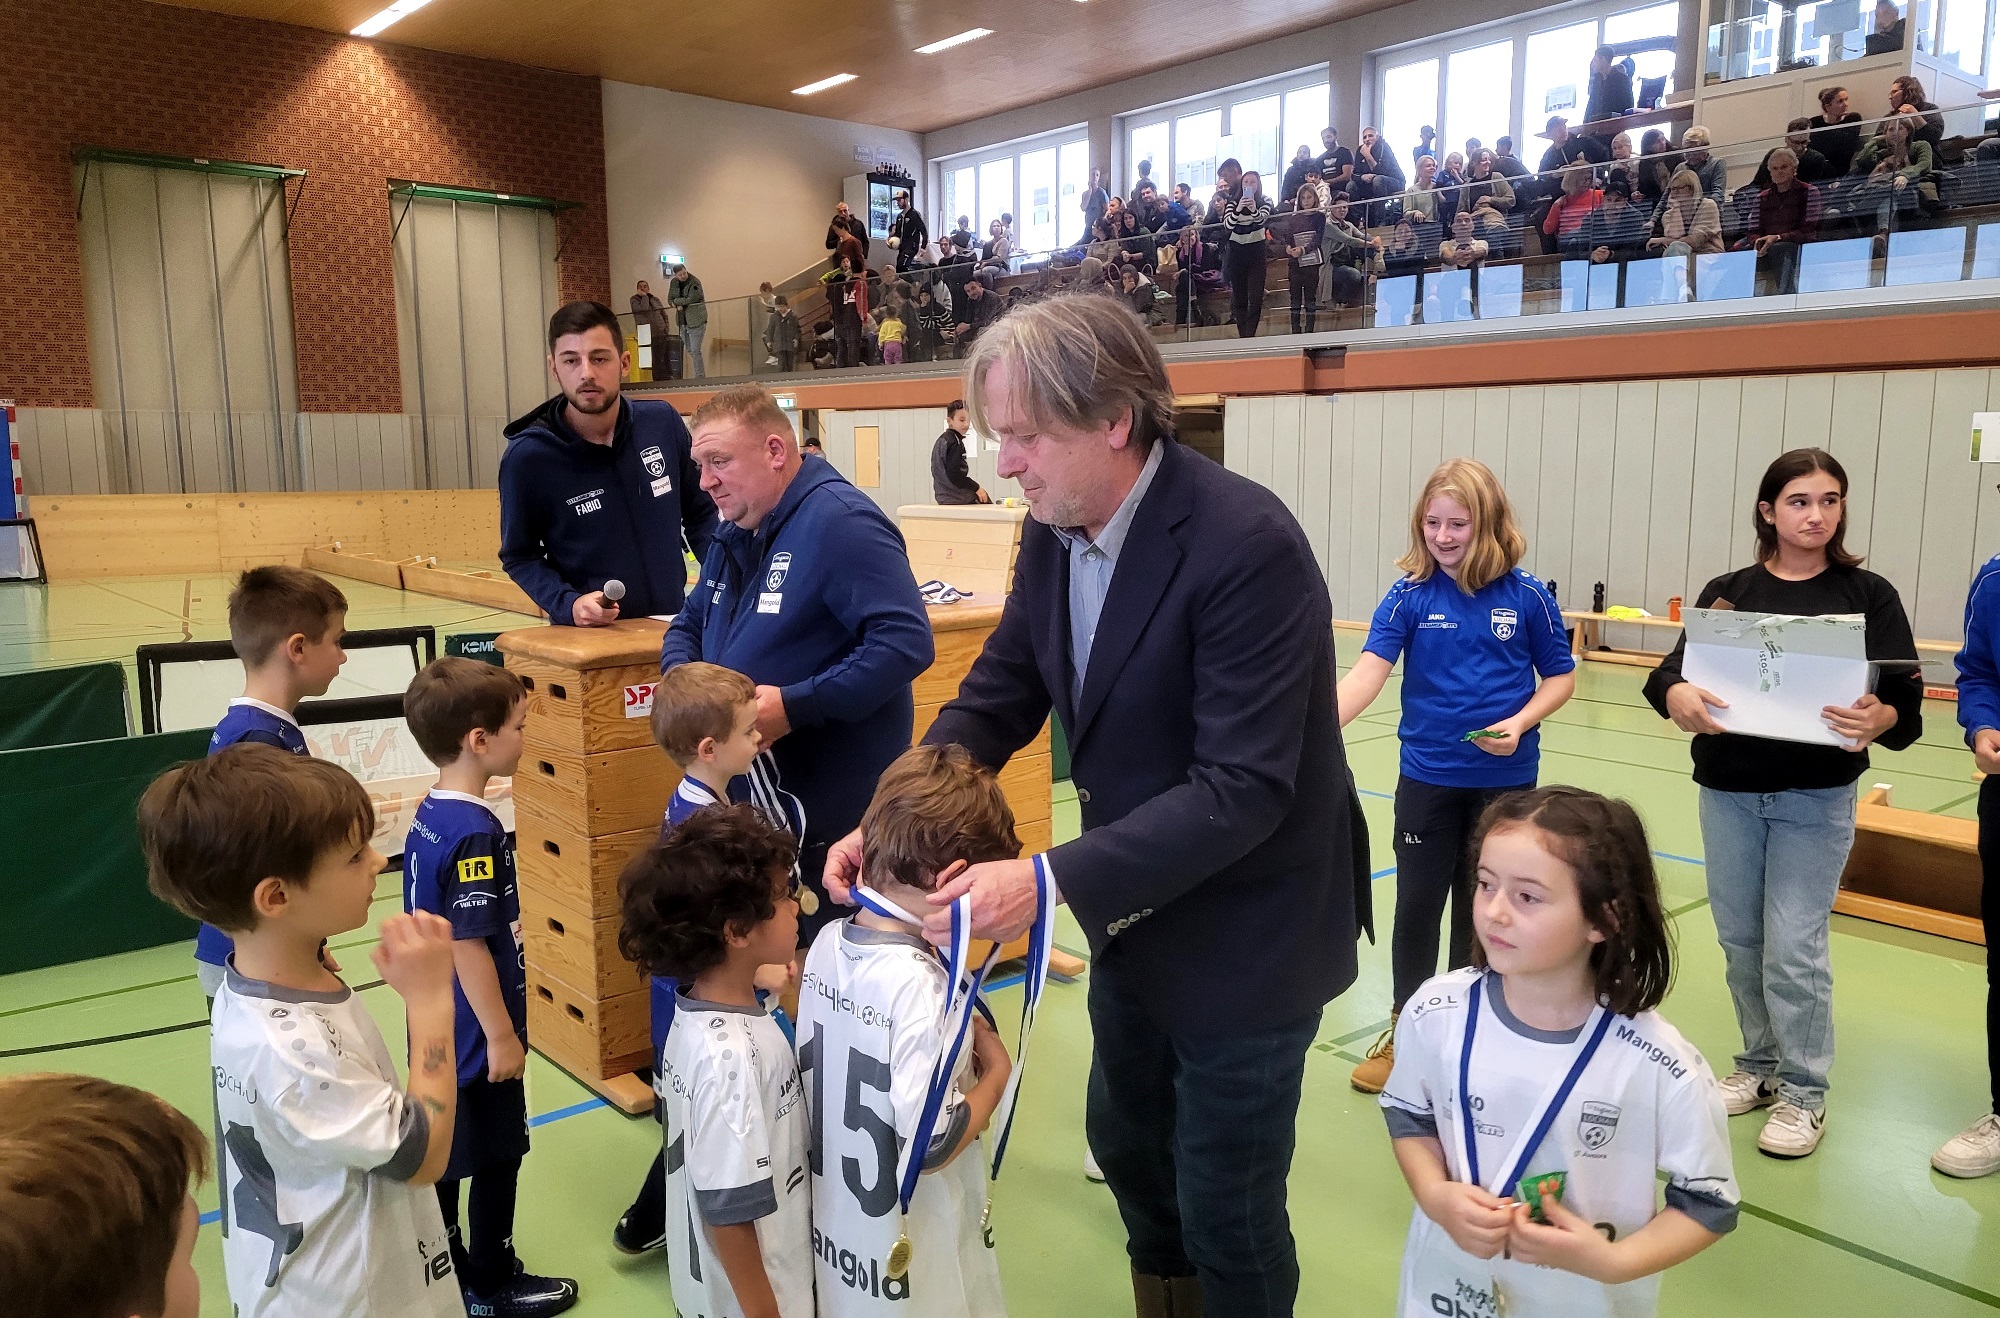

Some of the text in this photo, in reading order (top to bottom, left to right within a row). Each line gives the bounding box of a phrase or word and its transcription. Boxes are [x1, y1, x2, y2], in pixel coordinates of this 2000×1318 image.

[575, 498, 602, 516] FABIO
[760, 598, 780, 607] Mangold
[1427, 613, 1446, 621] JAKO
[1413, 995, 1458, 1014] WOL
[1615, 1024, 1688, 1080] Mangold
[799, 1020, 898, 1217] 15
[470, 1303, 496, 1317] 001
